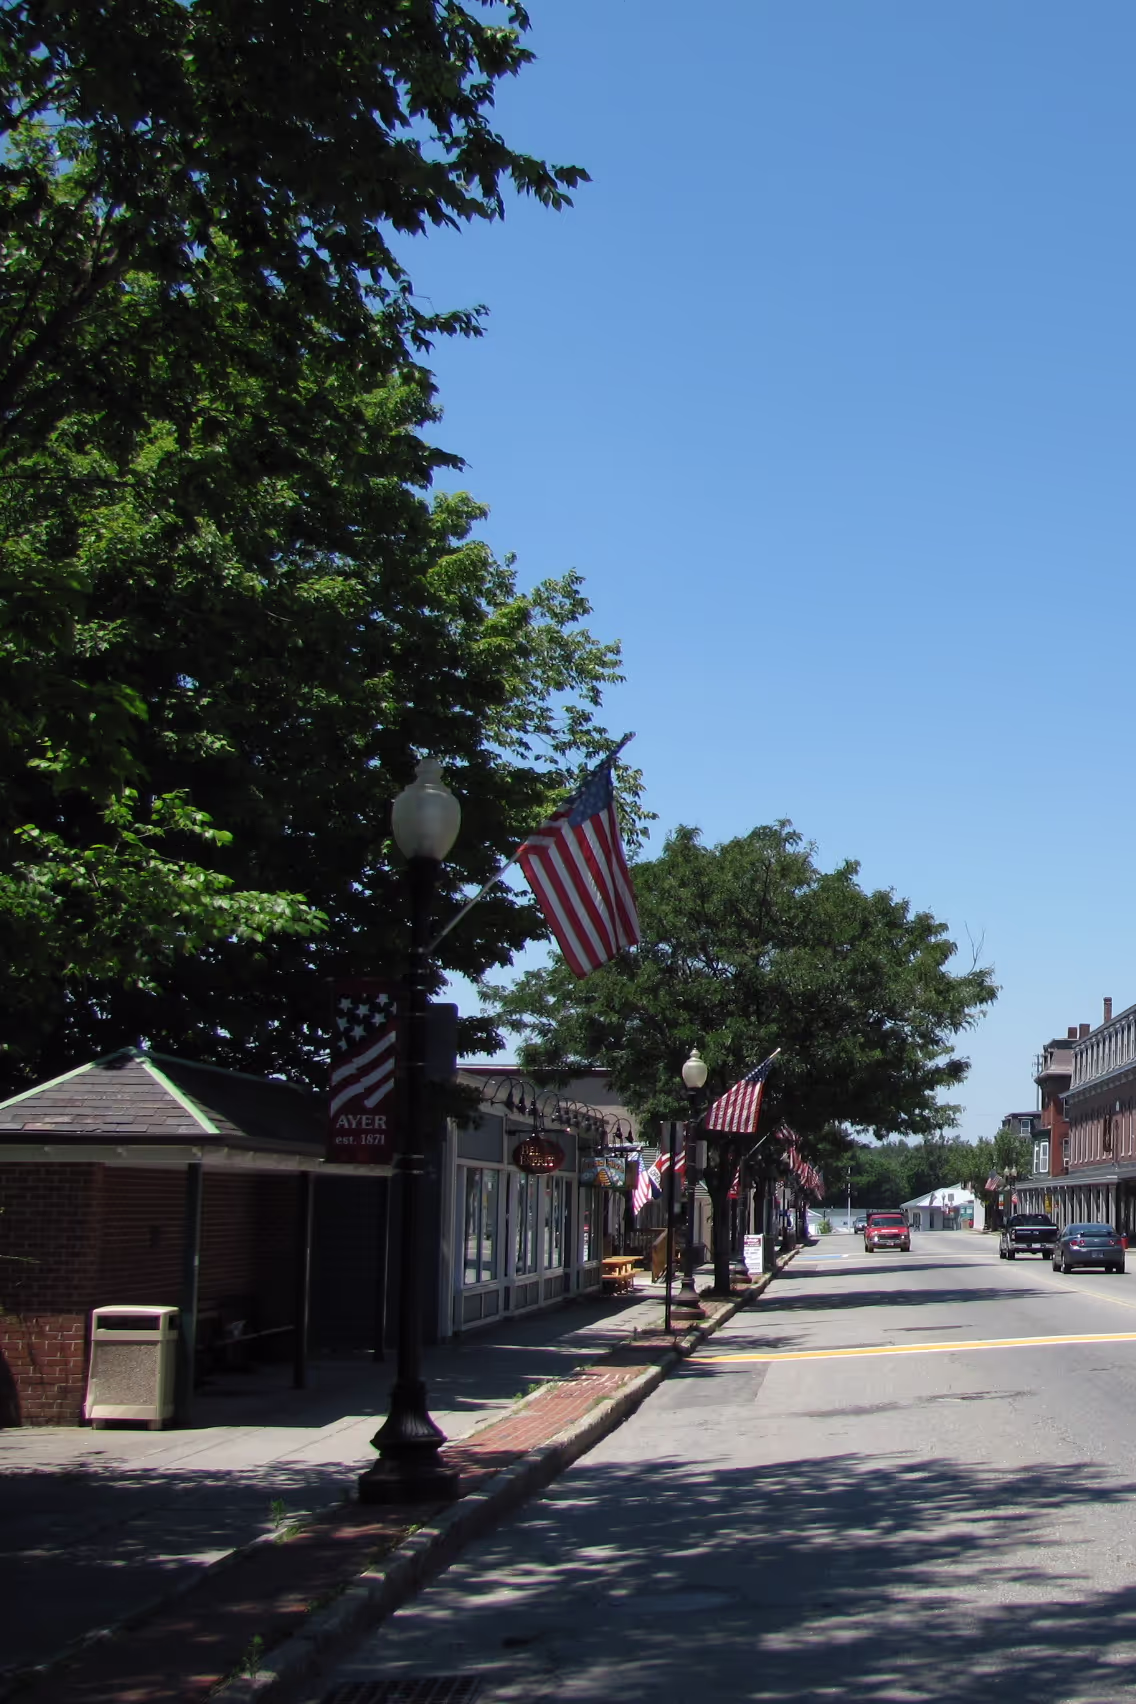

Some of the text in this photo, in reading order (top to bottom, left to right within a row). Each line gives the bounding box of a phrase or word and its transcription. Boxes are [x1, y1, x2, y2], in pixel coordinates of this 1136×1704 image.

[335, 1114, 387, 1129] AYER
[335, 1133, 385, 1145] est. 1871
